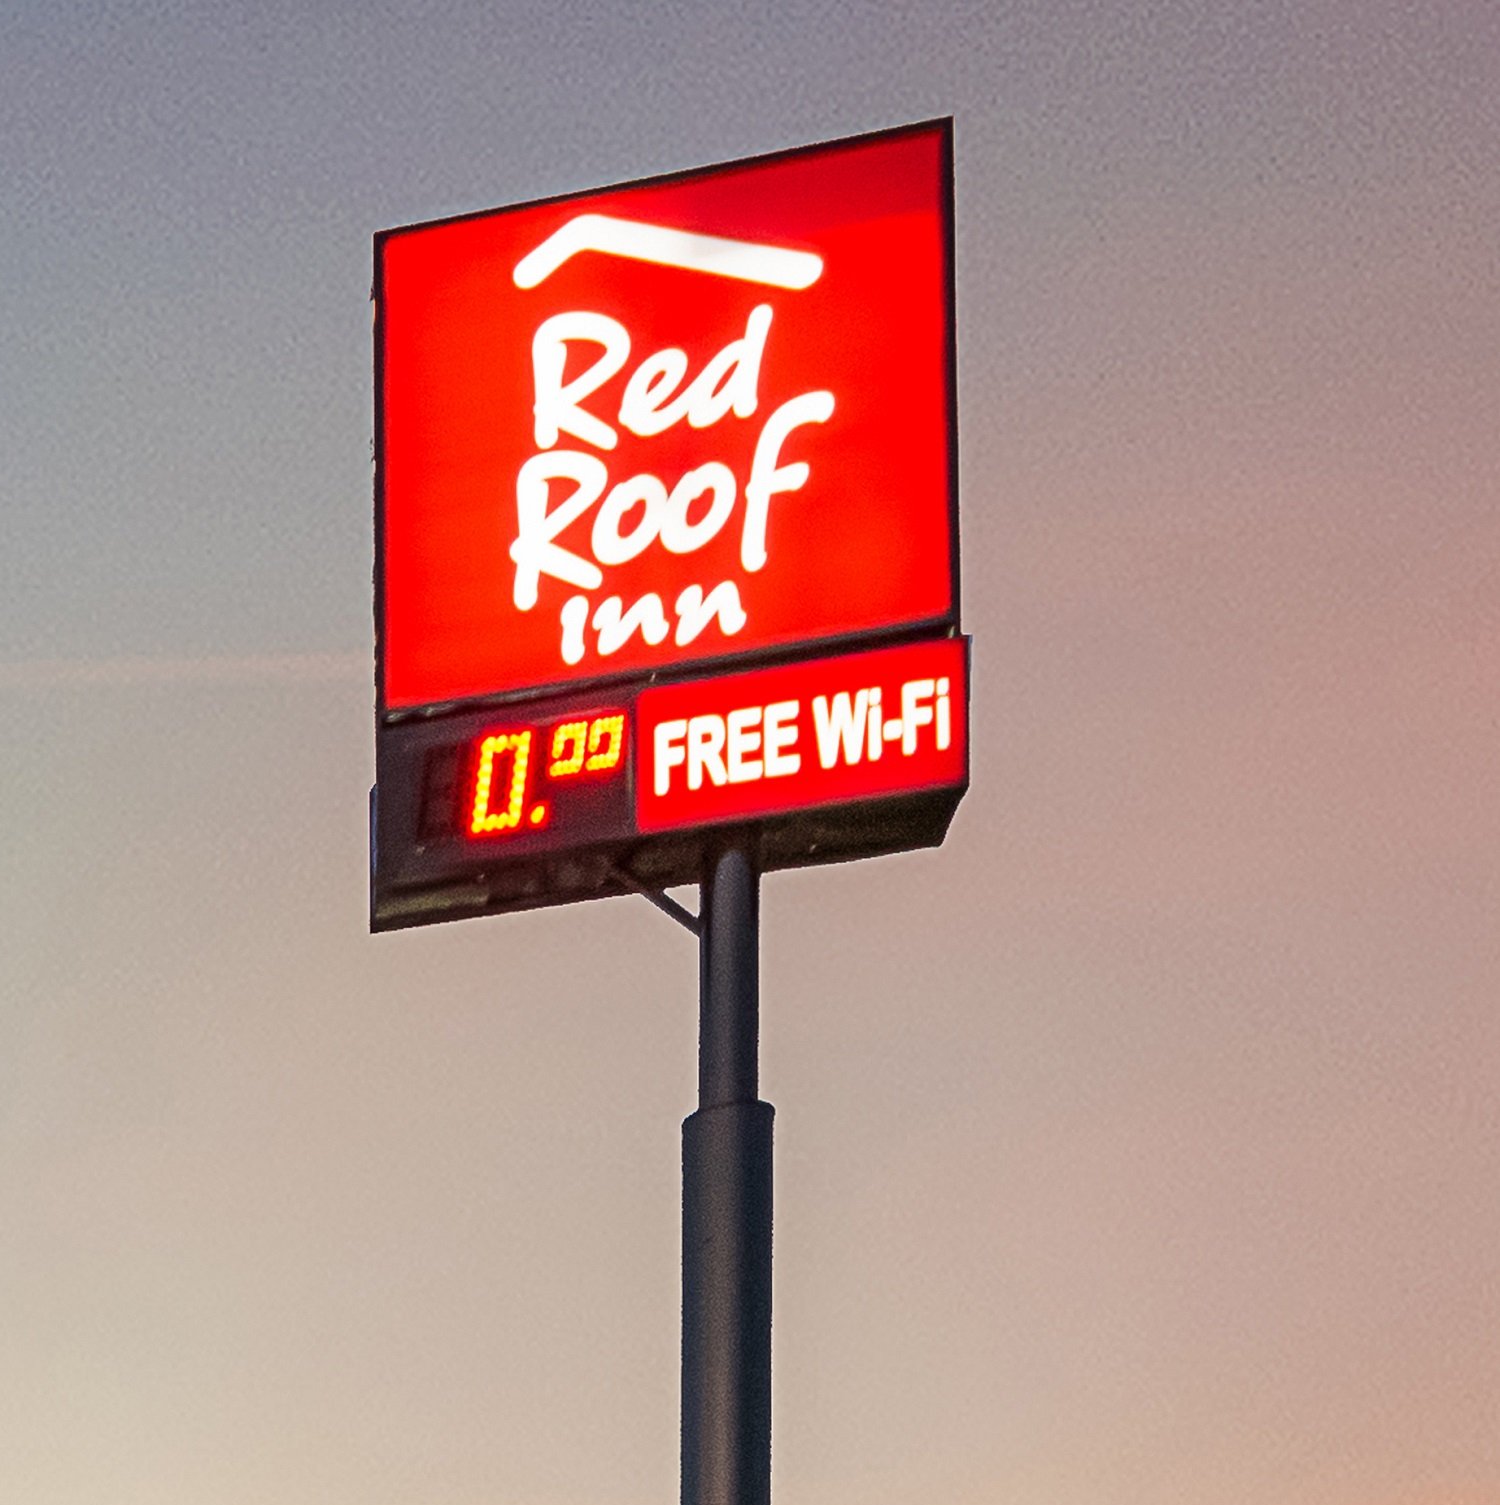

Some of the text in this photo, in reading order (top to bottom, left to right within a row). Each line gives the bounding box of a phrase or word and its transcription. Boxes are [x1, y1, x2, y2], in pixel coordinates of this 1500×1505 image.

[531, 303, 774, 451] Red
[508, 390, 836, 611] Roof
[653, 677, 950, 796] FREE Wi-Fi
